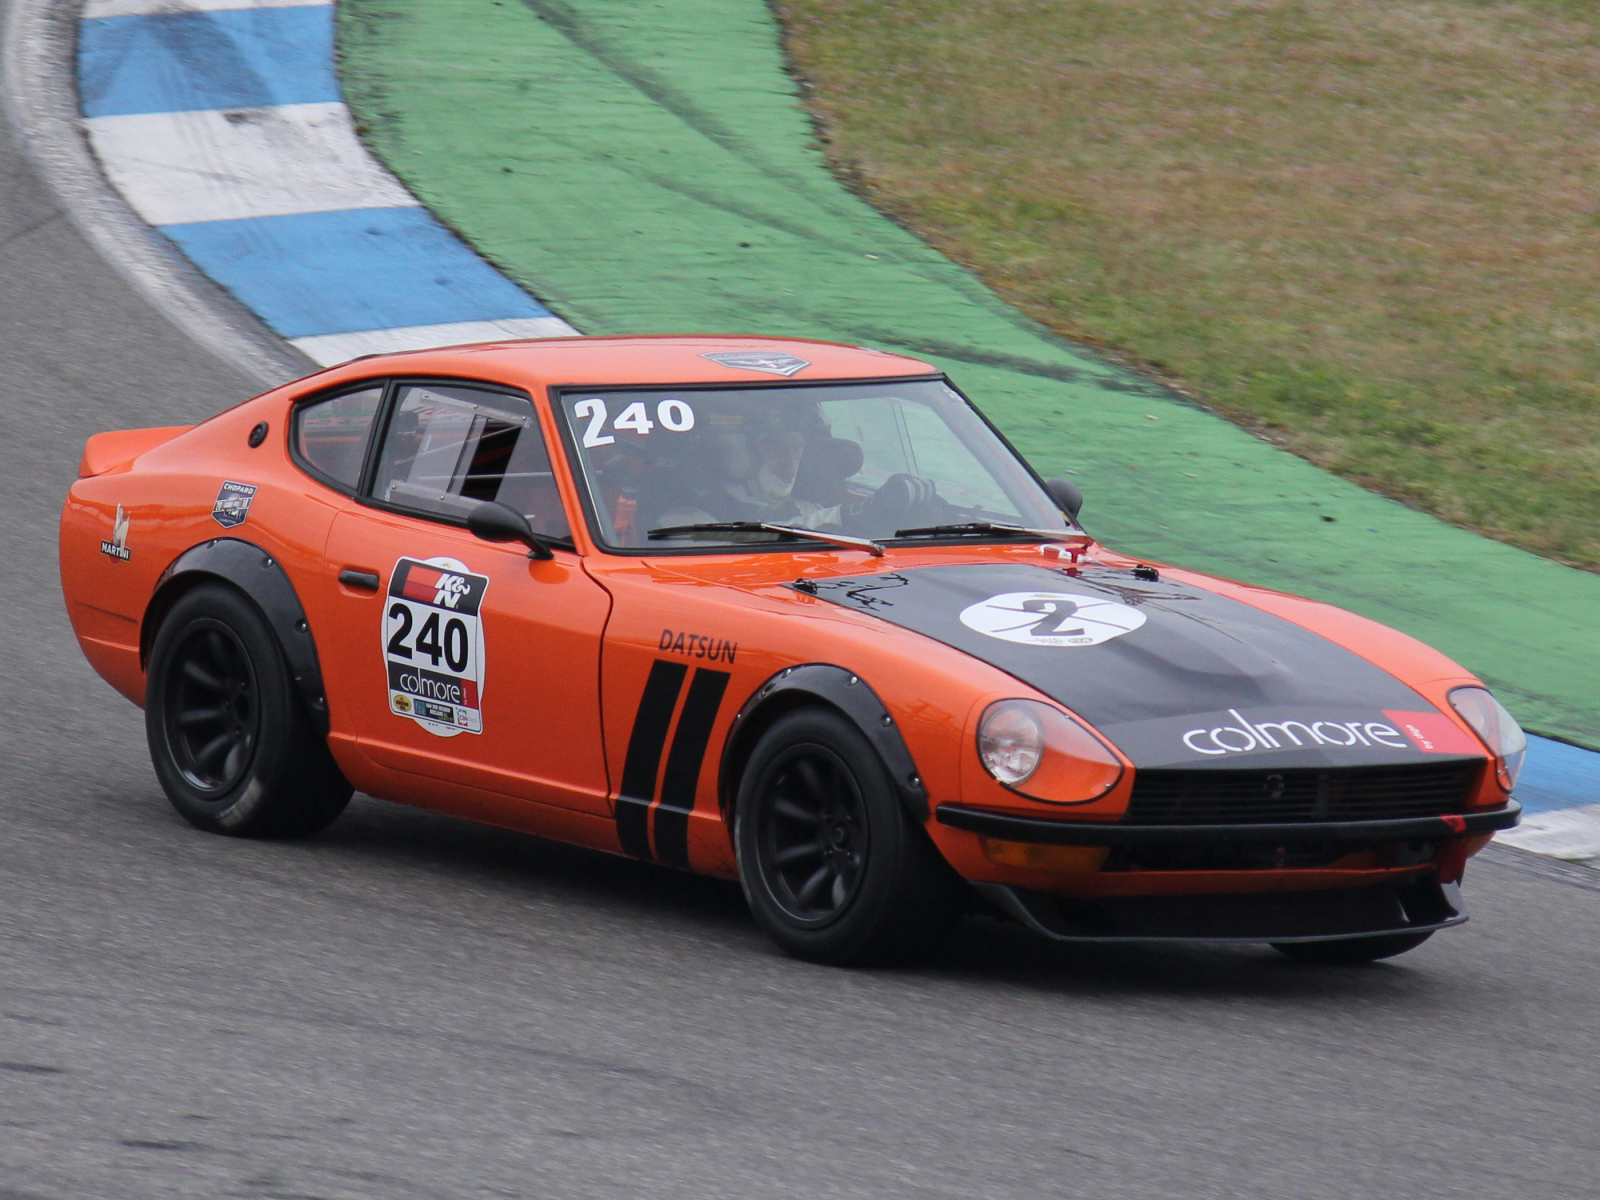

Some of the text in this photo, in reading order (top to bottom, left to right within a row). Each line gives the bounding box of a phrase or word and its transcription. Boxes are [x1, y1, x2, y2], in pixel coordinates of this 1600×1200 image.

[574, 398, 695, 449] 240
[223, 483, 254, 495] CHOPARD
[1022, 599, 1085, 637] 2
[387, 602, 469, 673] 240
[658, 628, 738, 665] DATSUN
[400, 666, 461, 703] colmore
[1183, 708, 1408, 755] colmore
